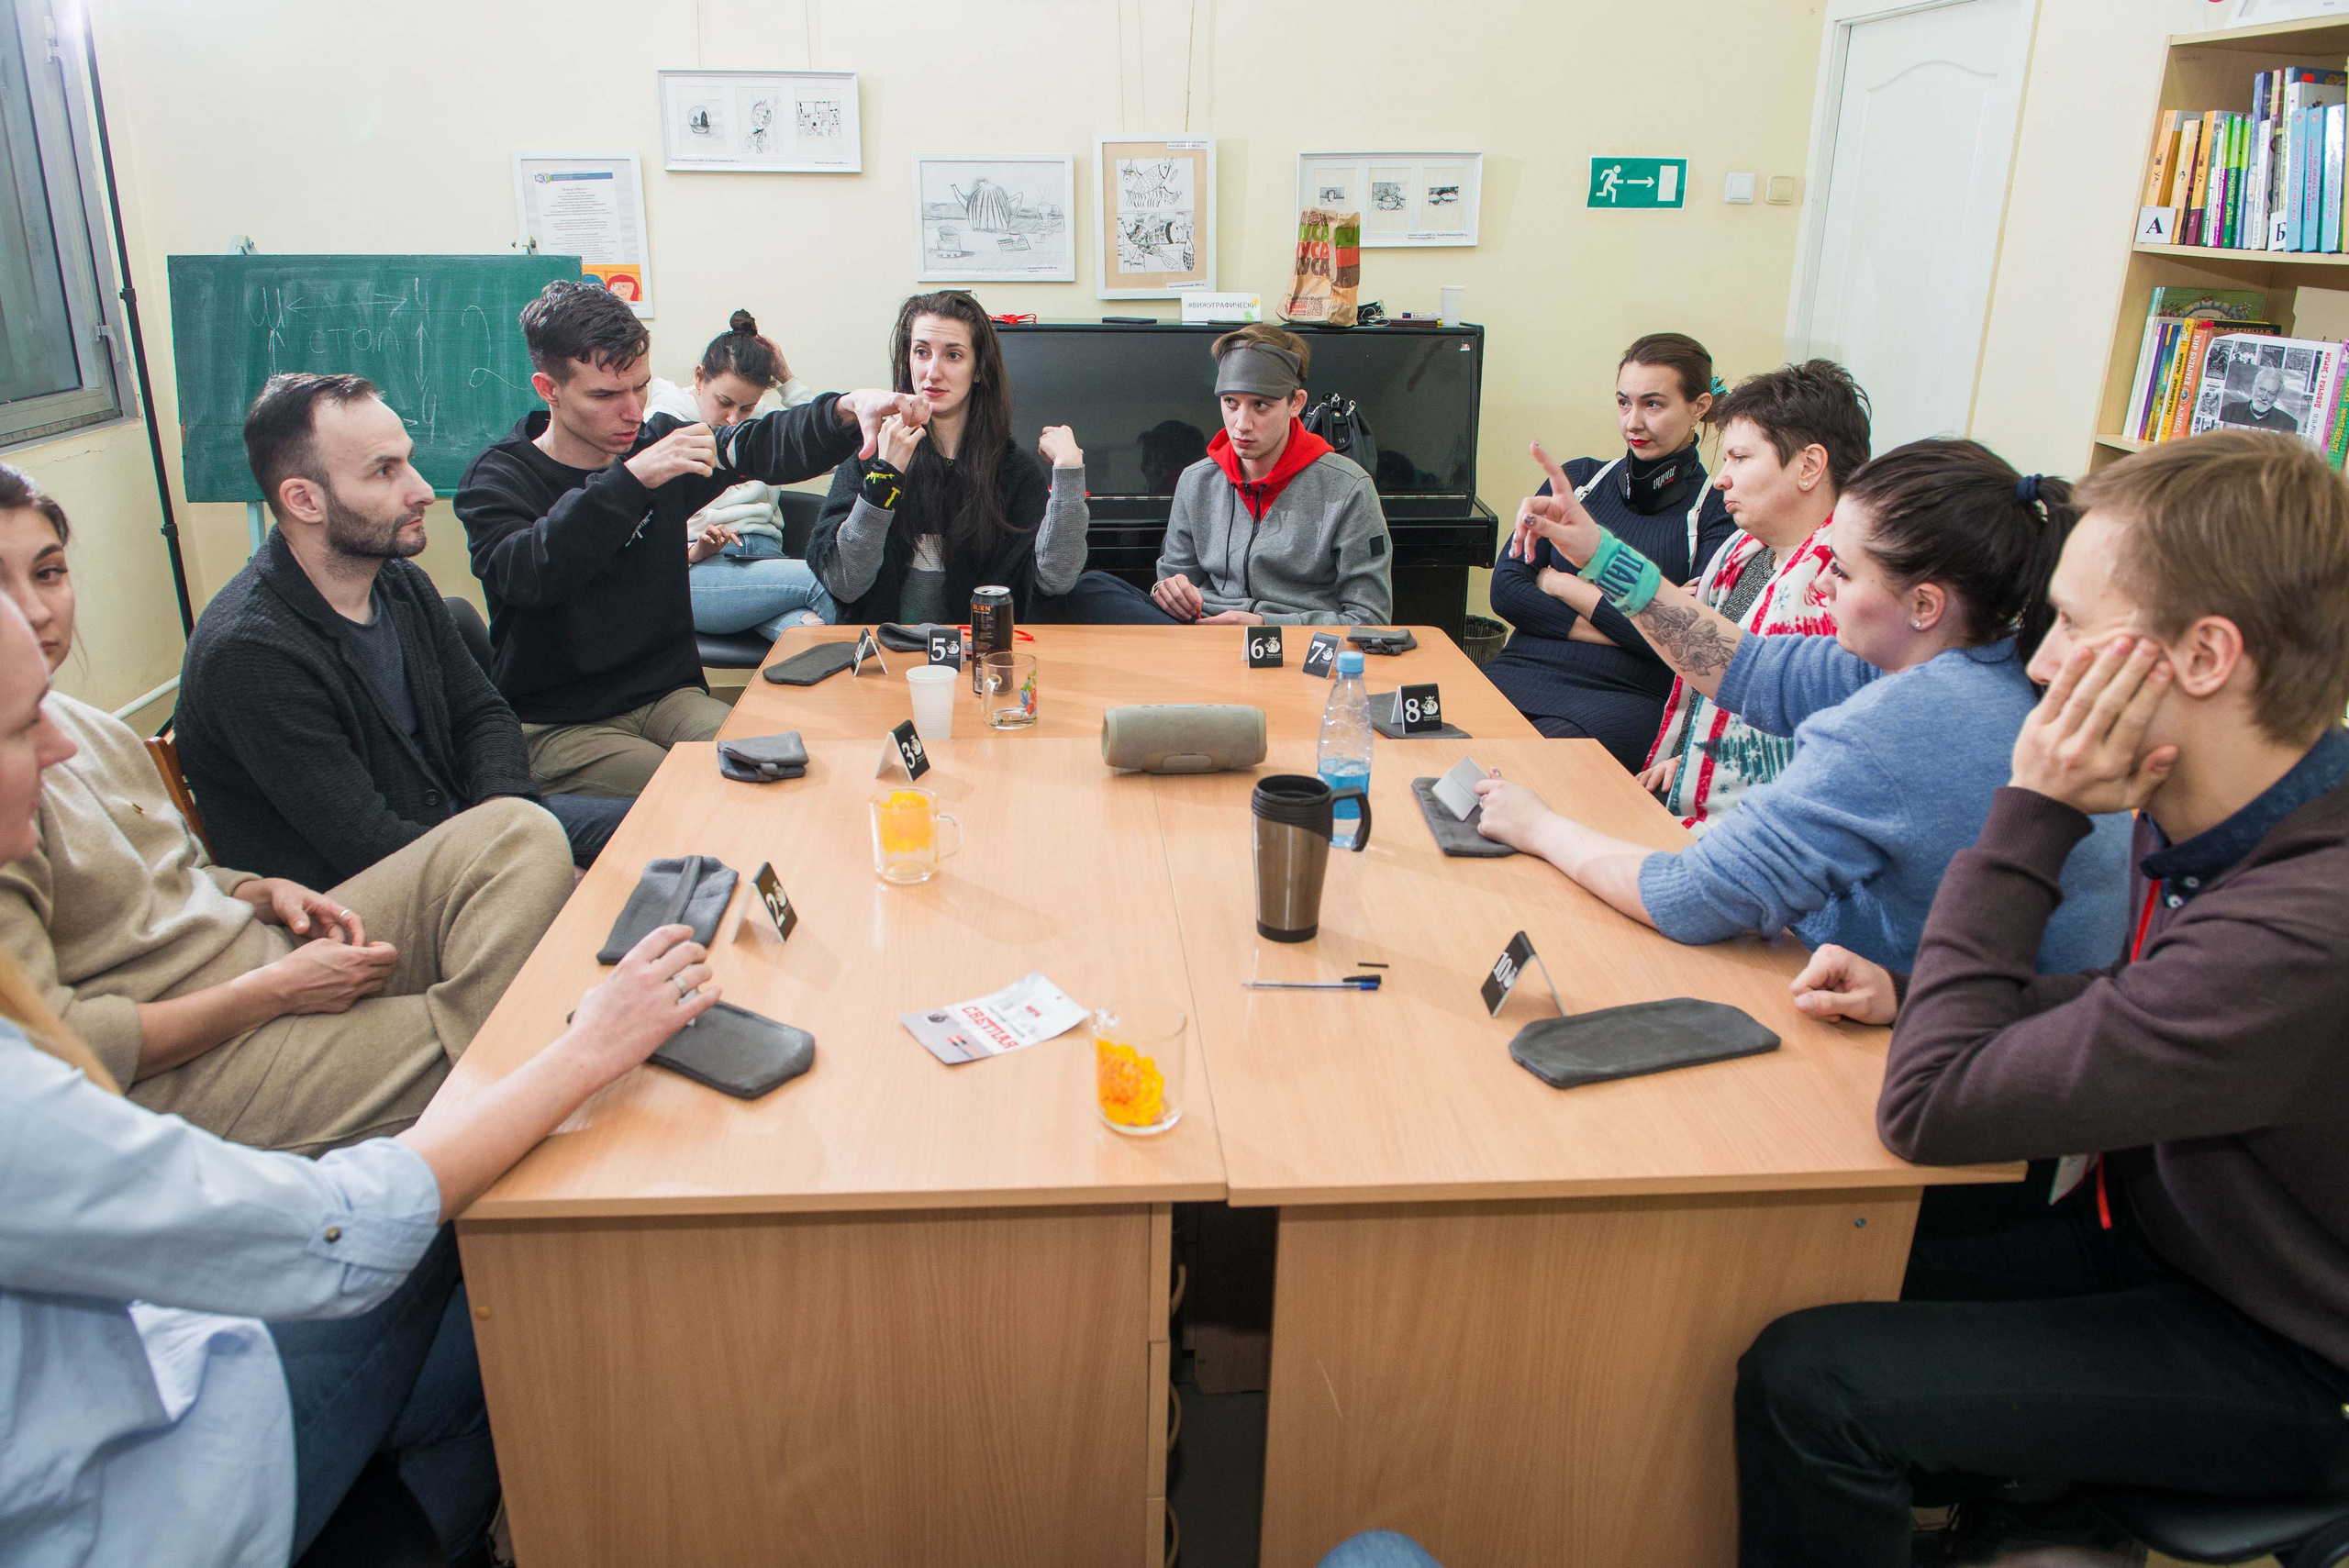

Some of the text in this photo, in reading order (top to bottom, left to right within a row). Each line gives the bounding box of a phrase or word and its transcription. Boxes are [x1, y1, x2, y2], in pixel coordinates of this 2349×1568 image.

[2145, 217, 2164, 234] А
[2277, 222, 2286, 242] Б
[1187, 301, 1257, 310] #ВИЖУГРАФИЧЕСКИ
[2192, 334, 2201, 350] КИР
[2313, 380, 2327, 409] Девочка
[2321, 351, 2332, 373] Земли
[2330, 407, 2348, 452] ЗАПОВЕДНИК
[972, 604, 991, 612] BURN
[930, 637, 947, 662] 5
[1250, 637, 1264, 660] 6
[1308, 640, 1327, 664] 7
[1405, 698, 1421, 723] 8
[901, 742, 915, 769] 3
[765, 894, 786, 928] 2
[1492, 951, 1513, 983] 10
